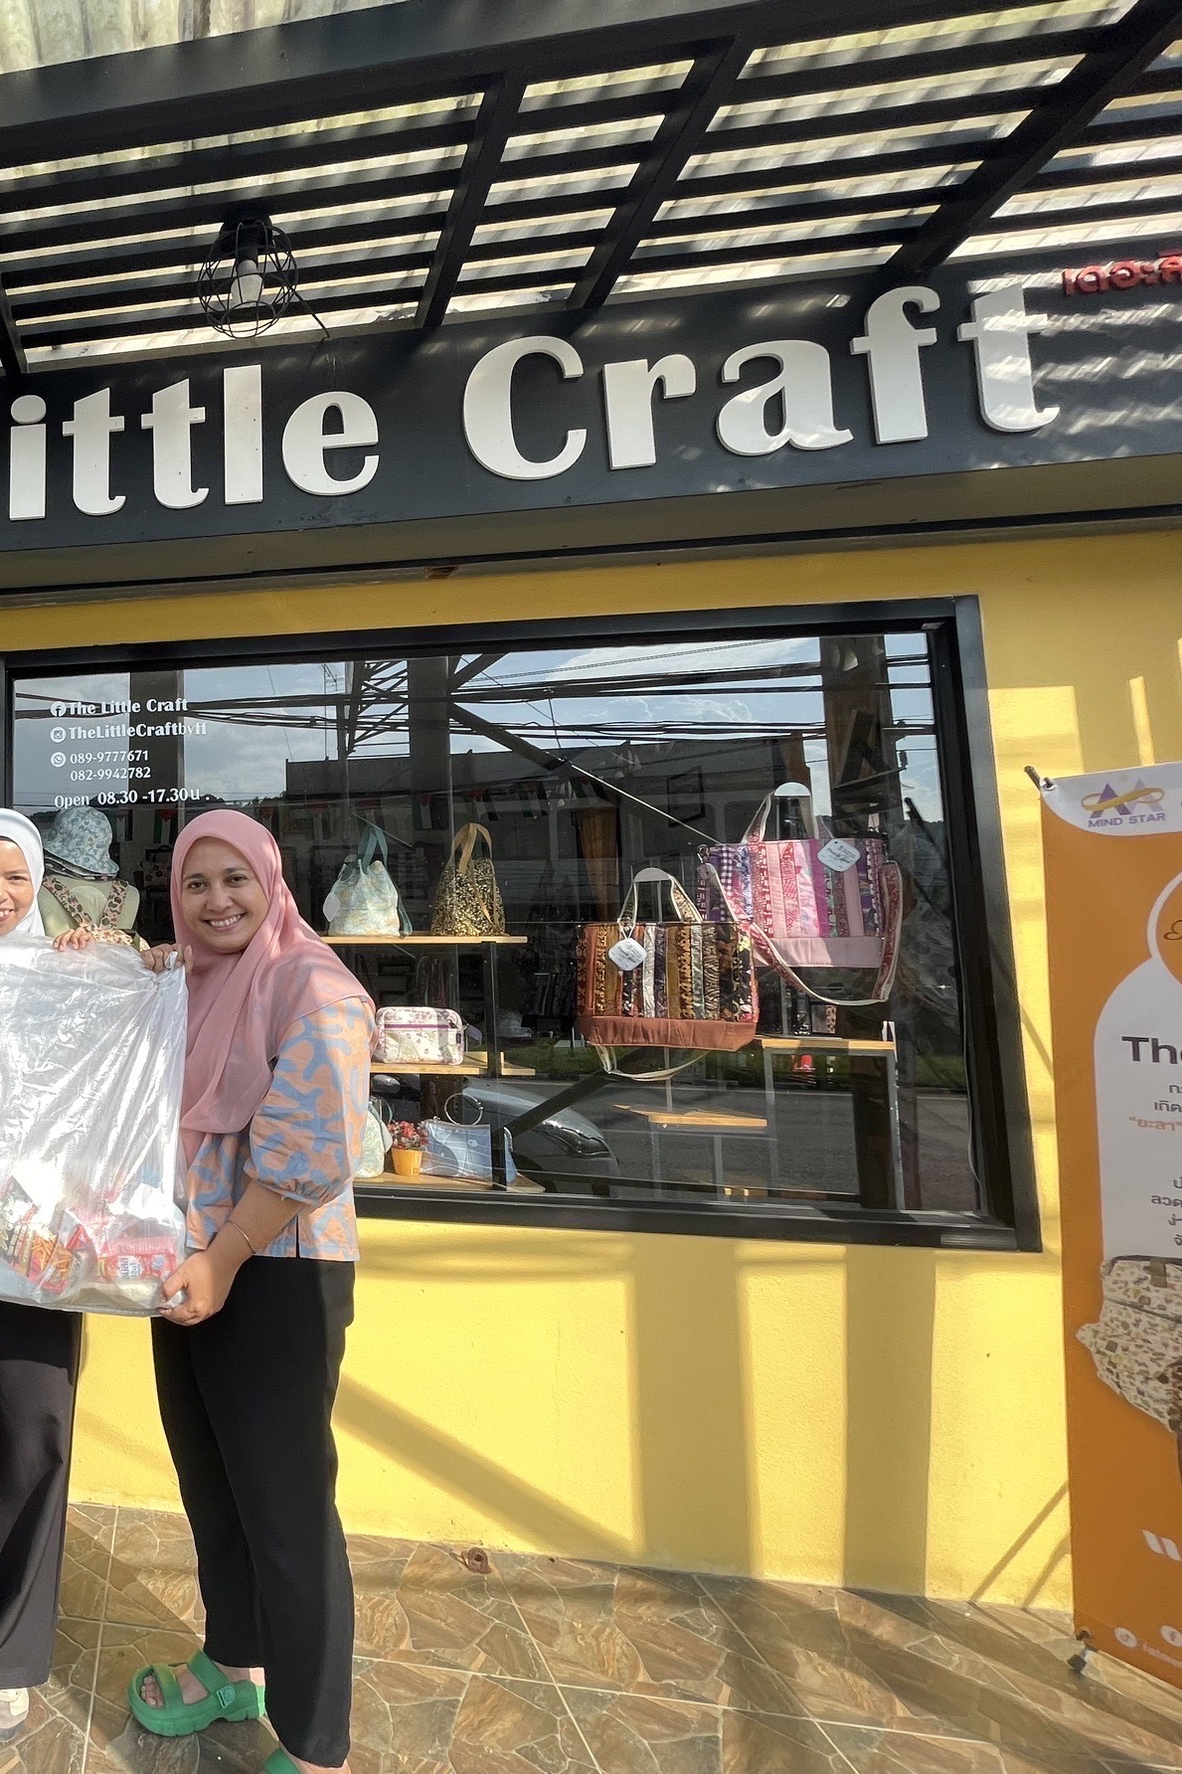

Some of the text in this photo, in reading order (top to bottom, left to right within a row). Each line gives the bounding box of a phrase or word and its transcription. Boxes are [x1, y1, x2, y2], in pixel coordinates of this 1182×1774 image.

[463, 285, 1062, 482] Craft
[68, 698, 189, 715] The Little Craft
[70, 750, 149, 764] 089-9777671
[70, 767, 152, 781] 082-9942782
[54, 794, 90, 809] Open
[98, 790, 138, 805] 08.30
[1088, 812, 1166, 828] MIND STAR
[1121, 1036, 1182, 1065] Th
